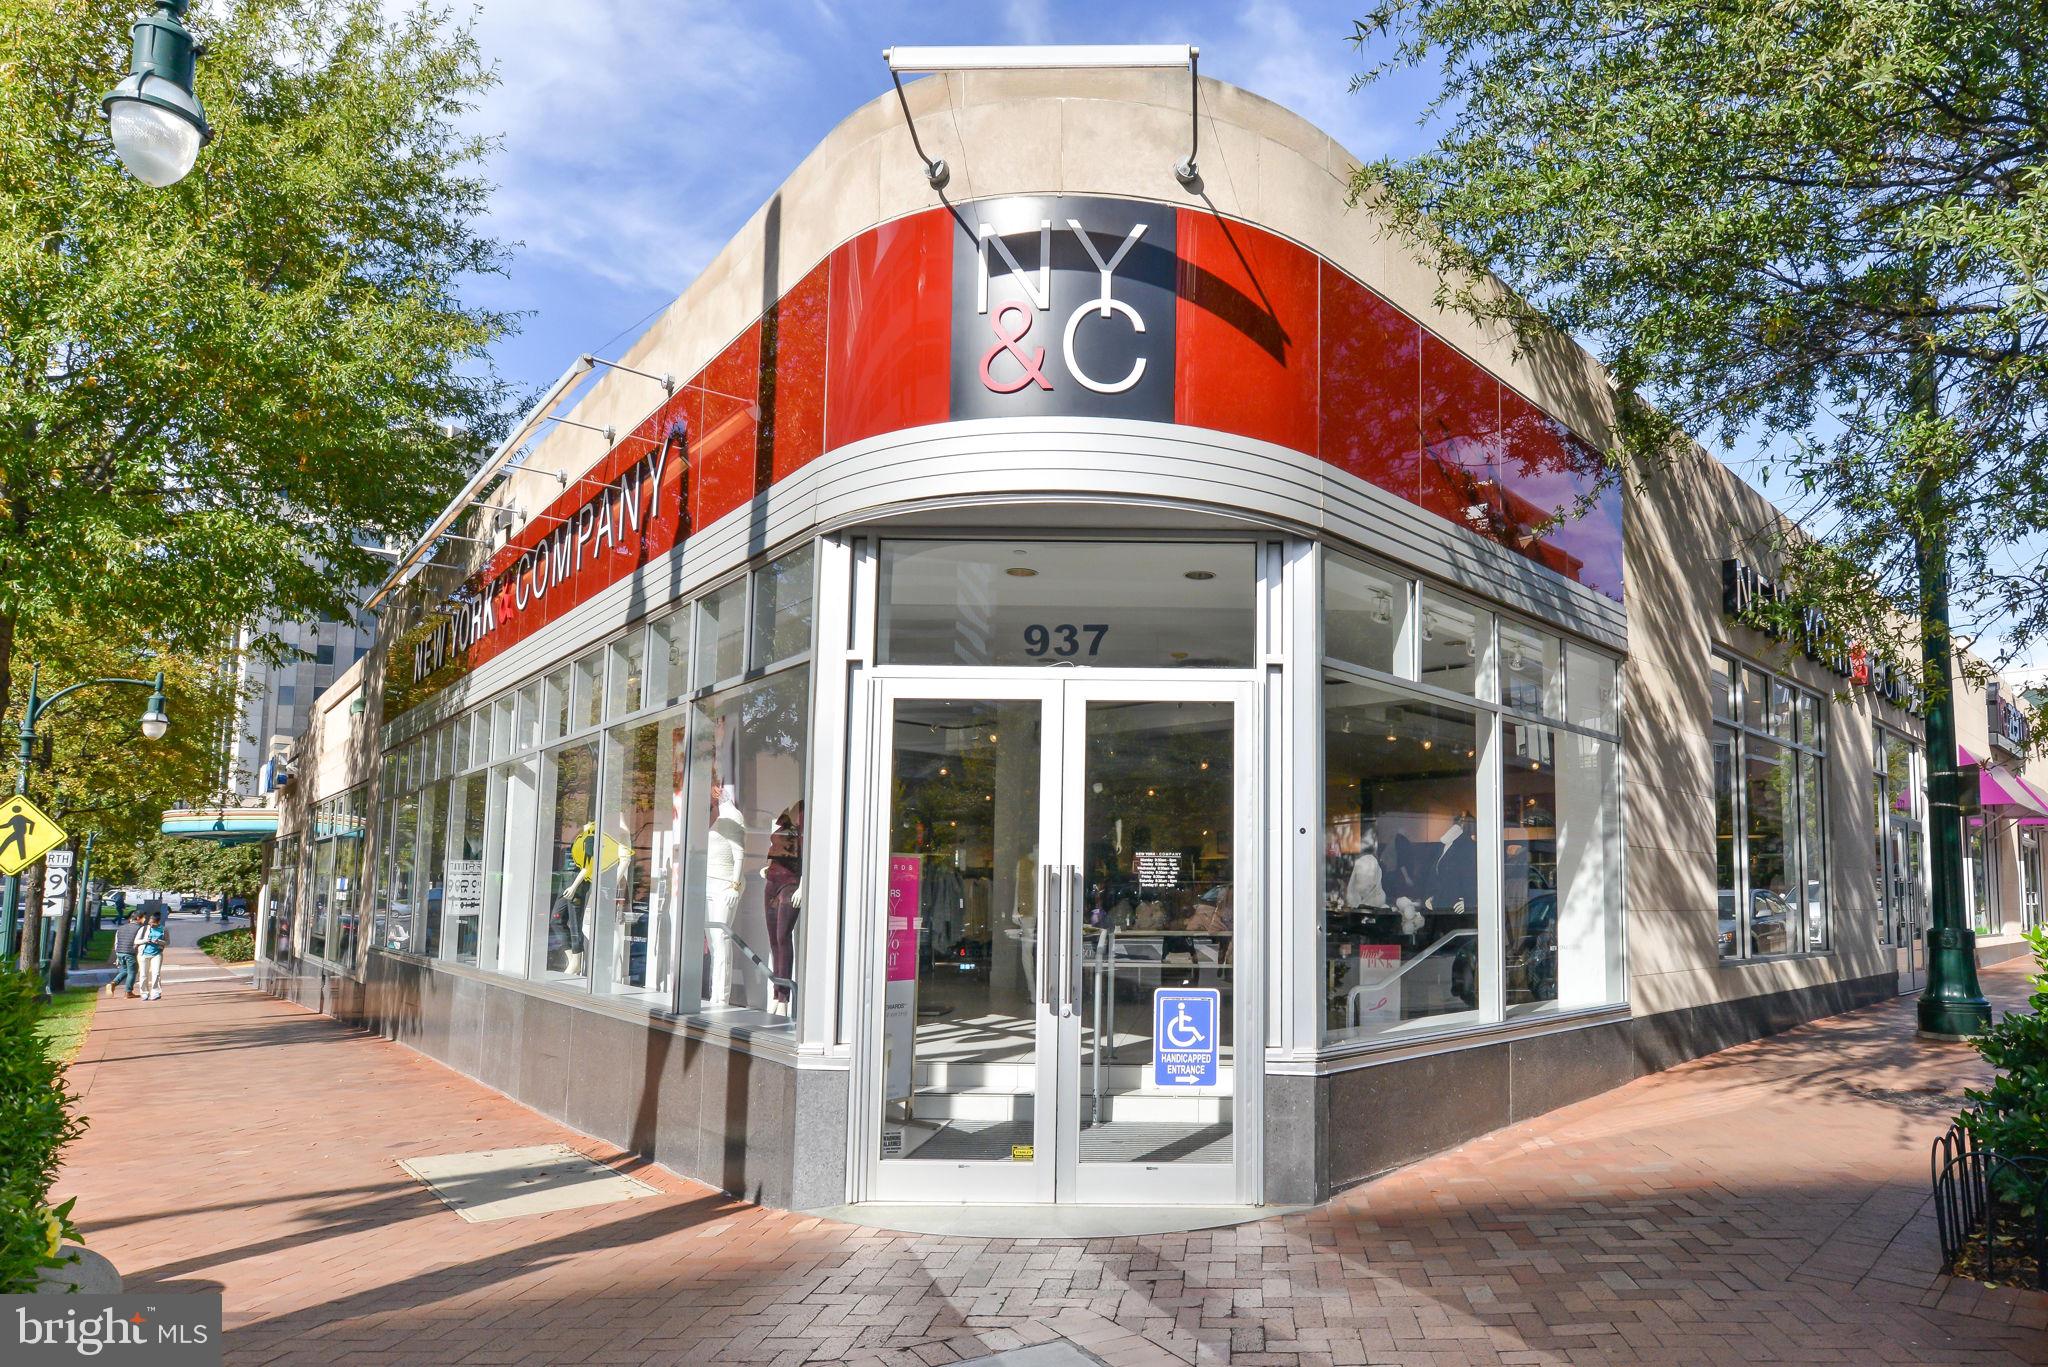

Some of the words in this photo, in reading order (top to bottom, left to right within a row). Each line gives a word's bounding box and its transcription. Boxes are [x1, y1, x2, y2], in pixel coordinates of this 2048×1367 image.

[978, 219, 1148, 318] NY
[414, 622, 447, 684] NEW
[451, 581, 496, 658] YORK
[516, 438, 672, 612] COMPANY
[1024, 624, 1109, 657] 937
[48, 854, 70, 864] RTH
[49, 874, 63, 890] 9
[1161, 1053, 1212, 1064] HANDICAPPED
[1167, 1064, 1206, 1075] ENTRANCE
